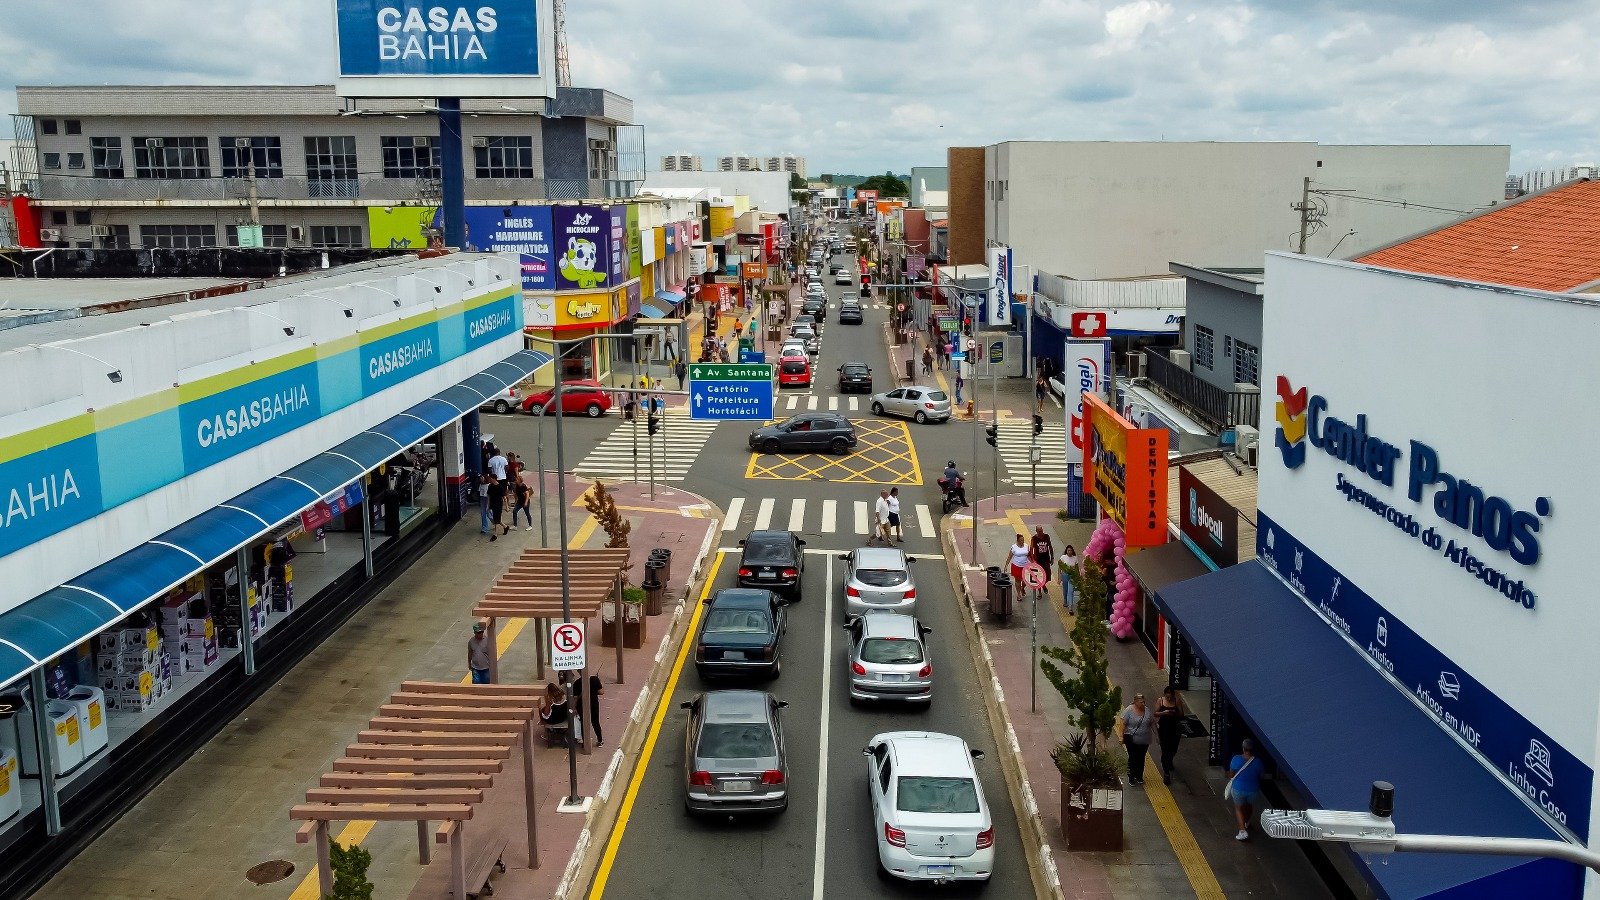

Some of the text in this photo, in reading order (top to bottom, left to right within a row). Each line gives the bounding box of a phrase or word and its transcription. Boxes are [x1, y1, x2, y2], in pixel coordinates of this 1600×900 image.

[377, 6, 498, 33] CASAS
[379, 34, 488, 60] BAHIA
[495, 231, 544, 241] HARDWARE
[504, 217, 534, 228] INGLÊS
[566, 226, 600, 234] MICROCAMP
[469, 309, 511, 339] CASASBAHIA
[369, 338, 433, 379] CASASBAHIA
[707, 384, 749, 393] Cartório
[707, 396, 759, 404] Prefeitura
[198, 383, 310, 448] CASASBAHIA
[707, 406, 758, 414] Hortofácil
[1148, 437, 1157, 530] DENTISTAS
[1307, 394, 1543, 567] Center Panos
[0, 468, 81, 527] AHIA
[1335, 472, 1538, 610] Supermercado do Artesanato
[1290, 571, 1306, 594] Linhas
[1319, 598, 1351, 634] Aviamentos
[1445, 711, 1458, 730] em
[1460, 720, 1481, 747] MDF
[1509, 761, 1567, 825] Linha Casa
